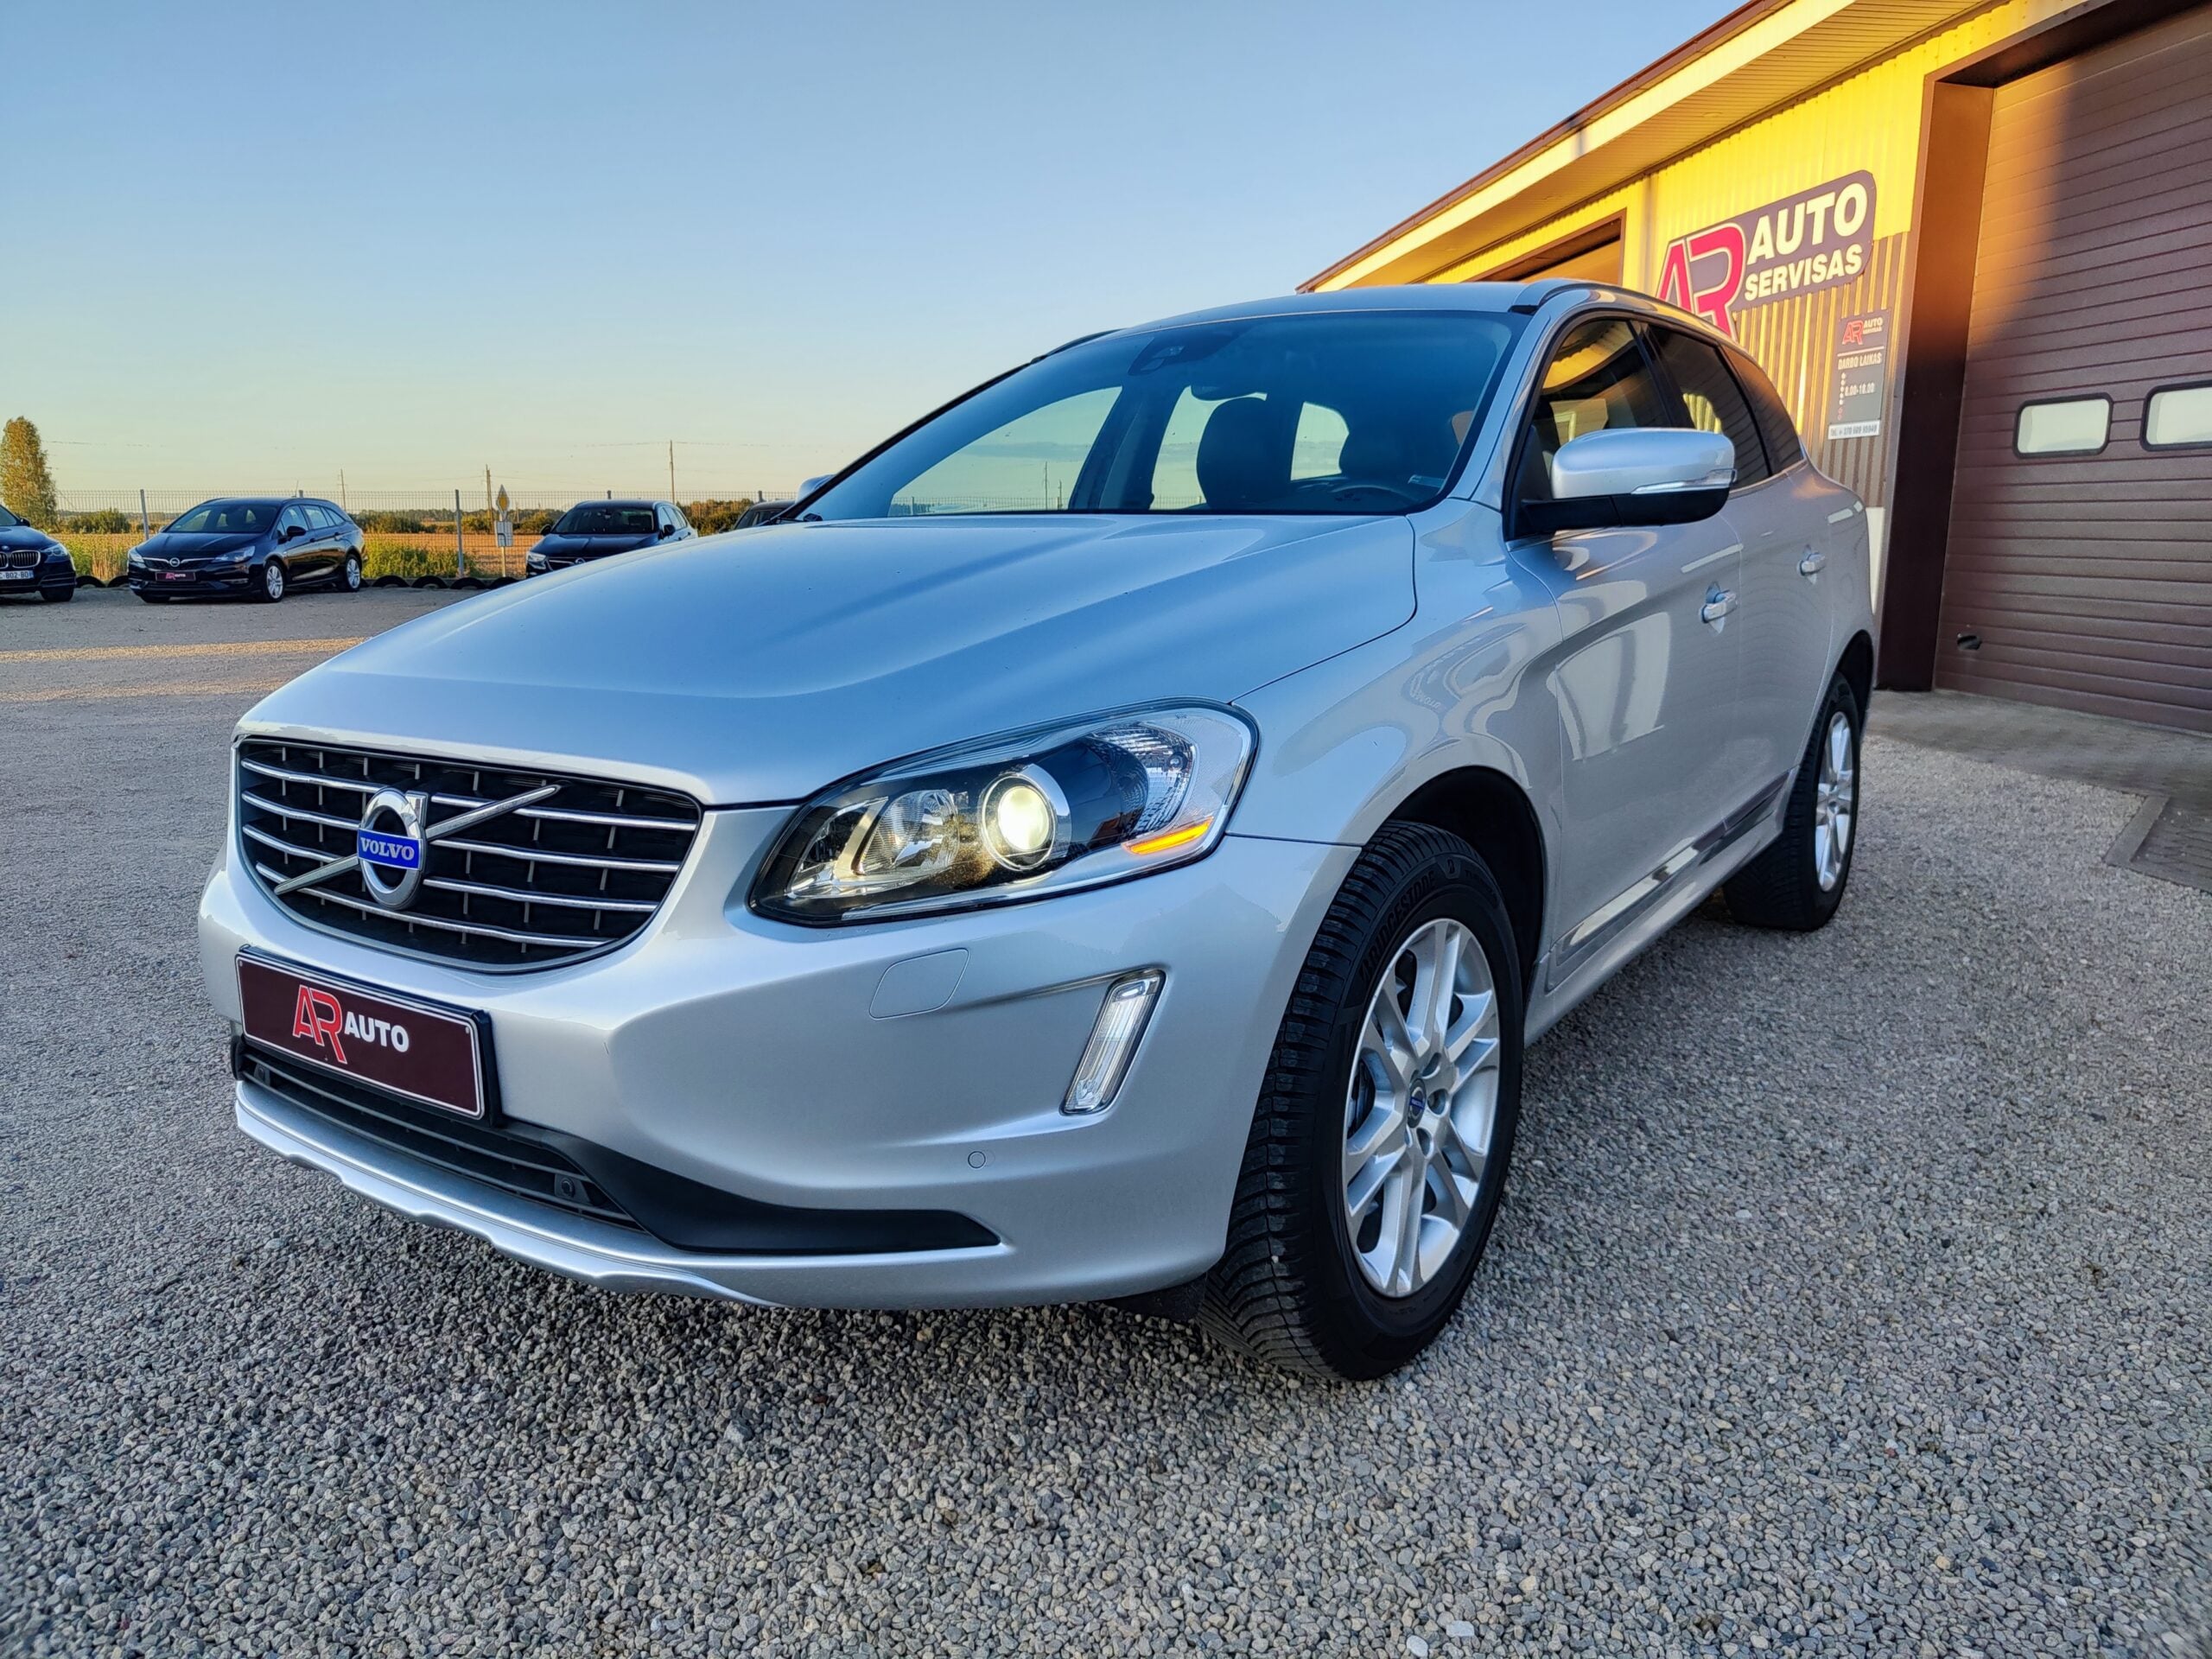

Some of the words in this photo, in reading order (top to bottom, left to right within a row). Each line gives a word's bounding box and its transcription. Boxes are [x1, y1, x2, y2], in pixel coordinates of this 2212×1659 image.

[1746, 182, 1868, 265] AUTO
[1745, 244, 1863, 302] SERVISAS
[1842, 320, 1864, 346] AR
[1863, 317, 1883, 328] AUTO
[1859, 352, 1883, 368] LAIKAS
[359, 836, 415, 861] VOLVO
[292, 984, 348, 1065] AR
[344, 1010, 410, 1053] AUTO
